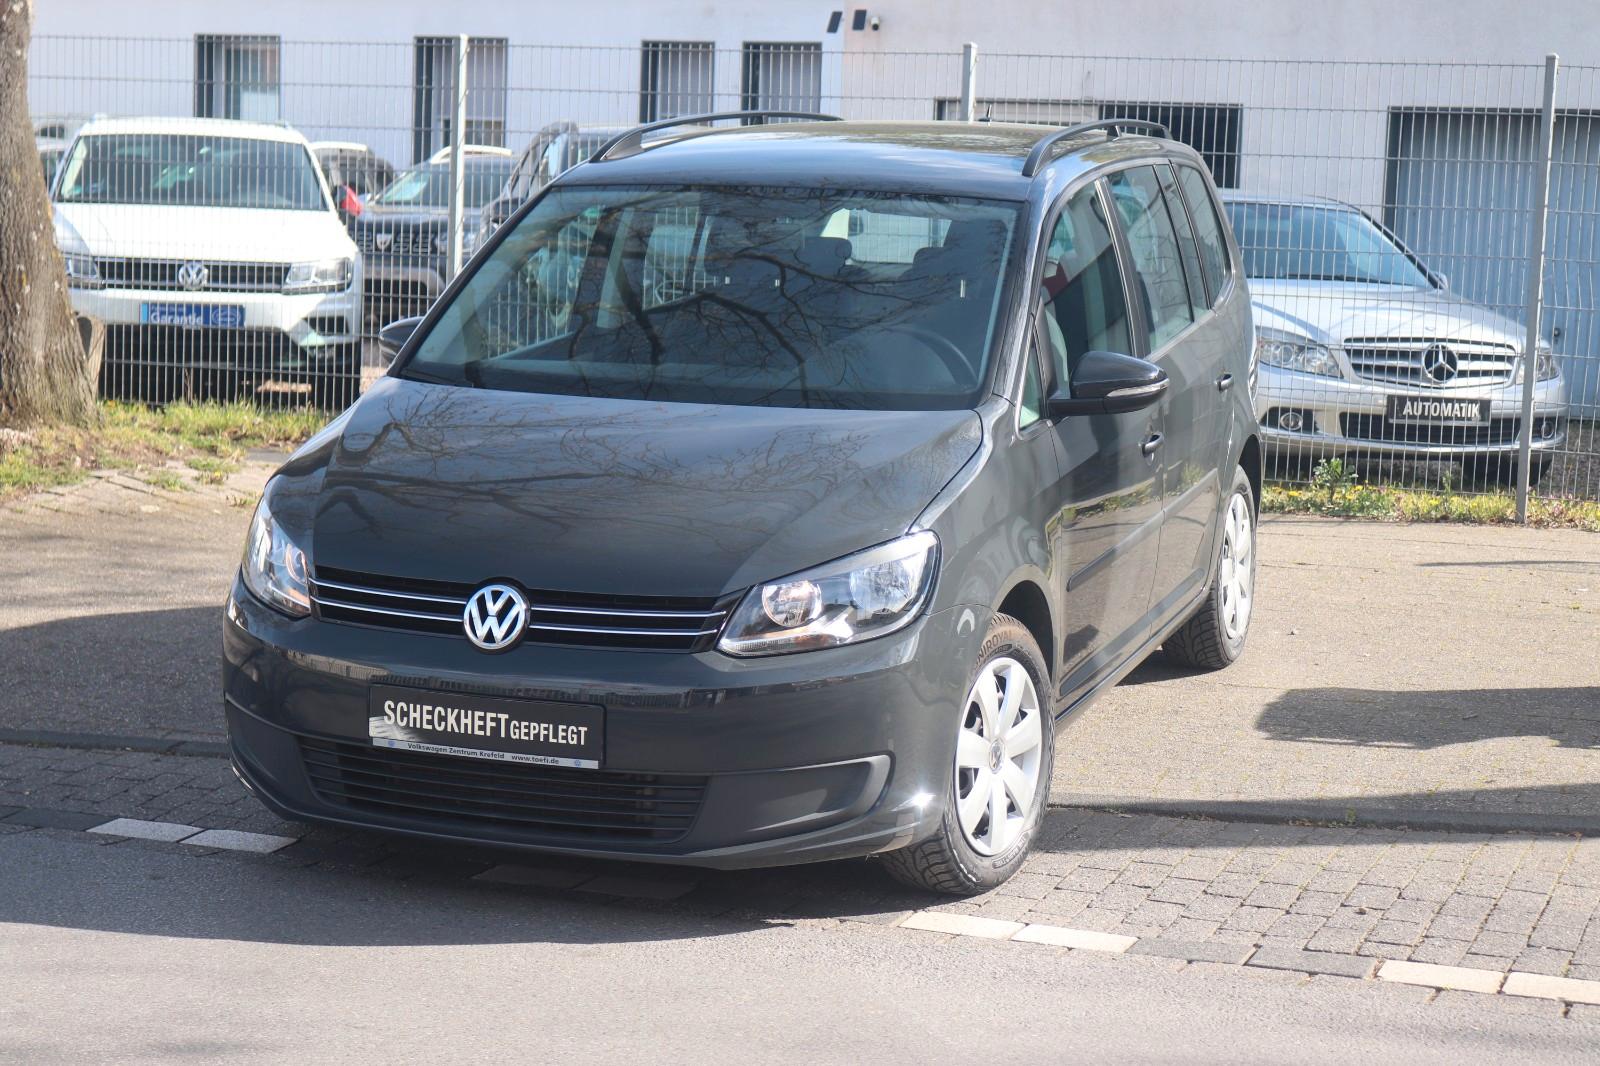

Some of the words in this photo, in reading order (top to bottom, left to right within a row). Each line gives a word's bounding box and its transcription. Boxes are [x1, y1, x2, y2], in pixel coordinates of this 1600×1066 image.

[1403, 401, 1480, 418] AUTOMATIK
[384, 700, 509, 738] SCHECKHEFT
[510, 720, 588, 746] GEPFLEGT
[407, 742, 448, 753] Volkswagen
[449, 747, 478, 757] Zentrum
[479, 751, 505, 759] Krefeld
[511, 754, 560, 765] www.toefi.de
